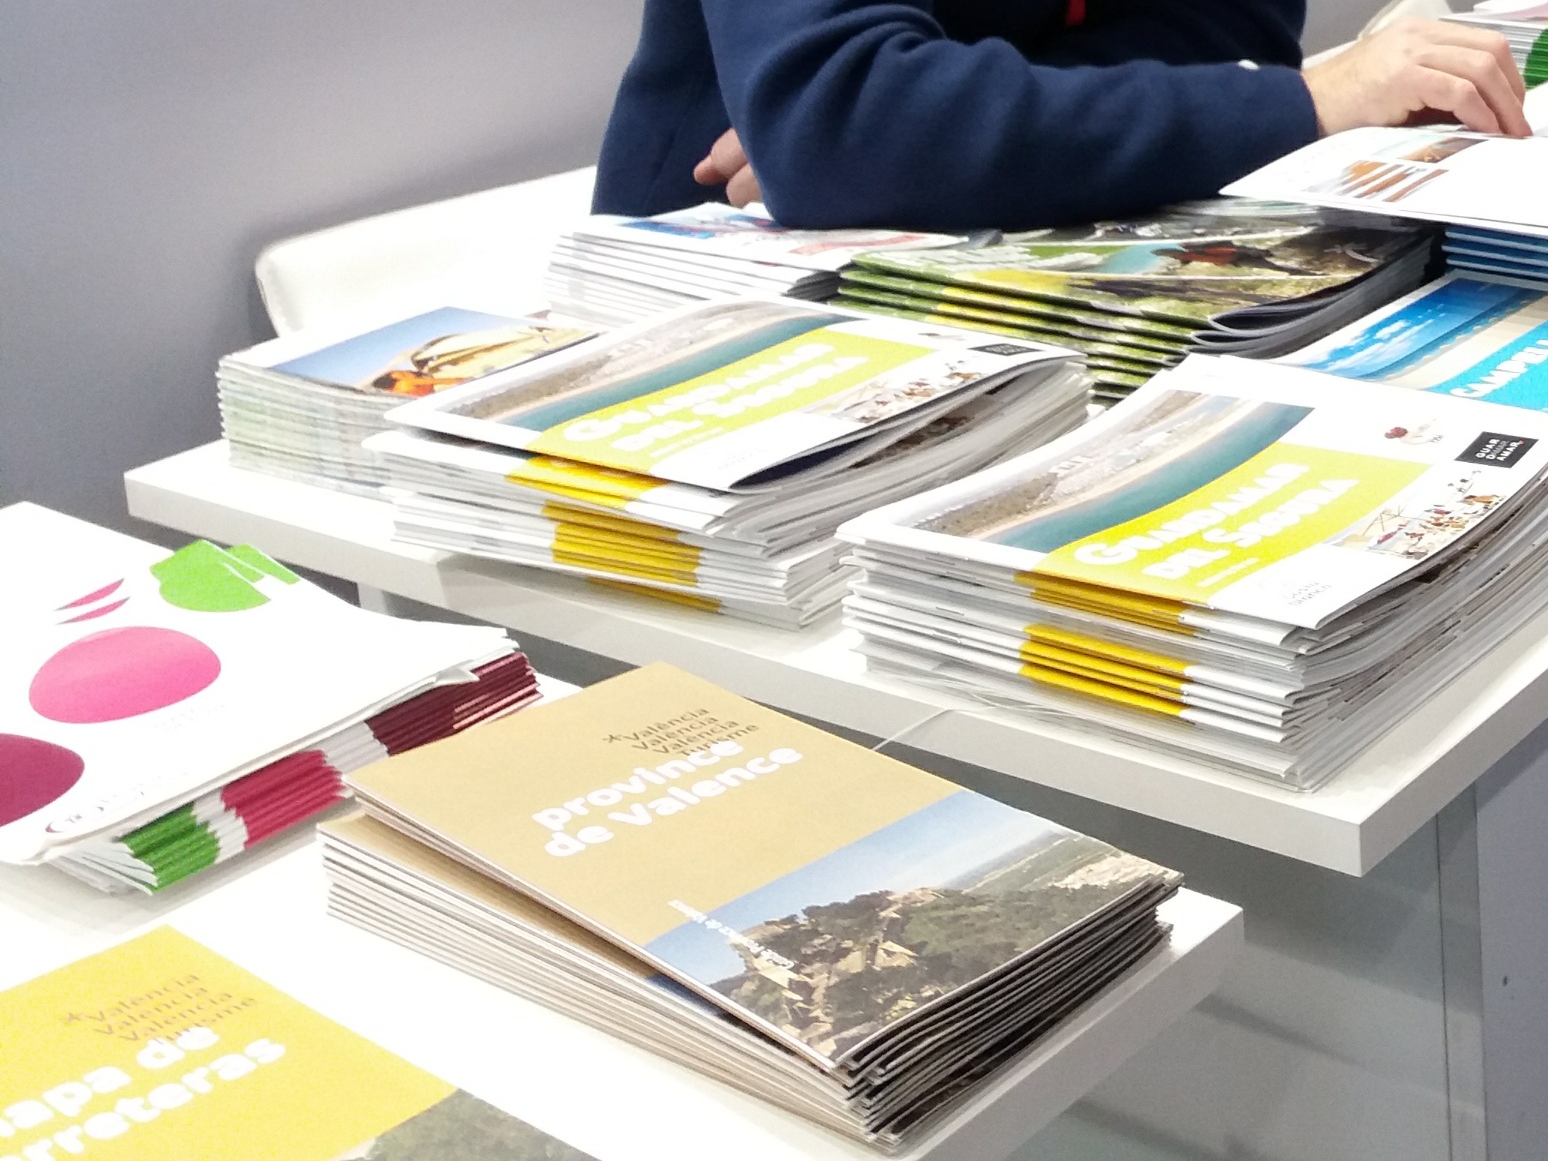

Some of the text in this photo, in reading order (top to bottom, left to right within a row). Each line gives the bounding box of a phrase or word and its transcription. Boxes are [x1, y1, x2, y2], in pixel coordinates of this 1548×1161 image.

[532, 740, 744, 831] province
[544, 748, 803, 857] de Valence
[0, 1026, 220, 1138] apa de
[0, 1039, 286, 1161] rreteras
